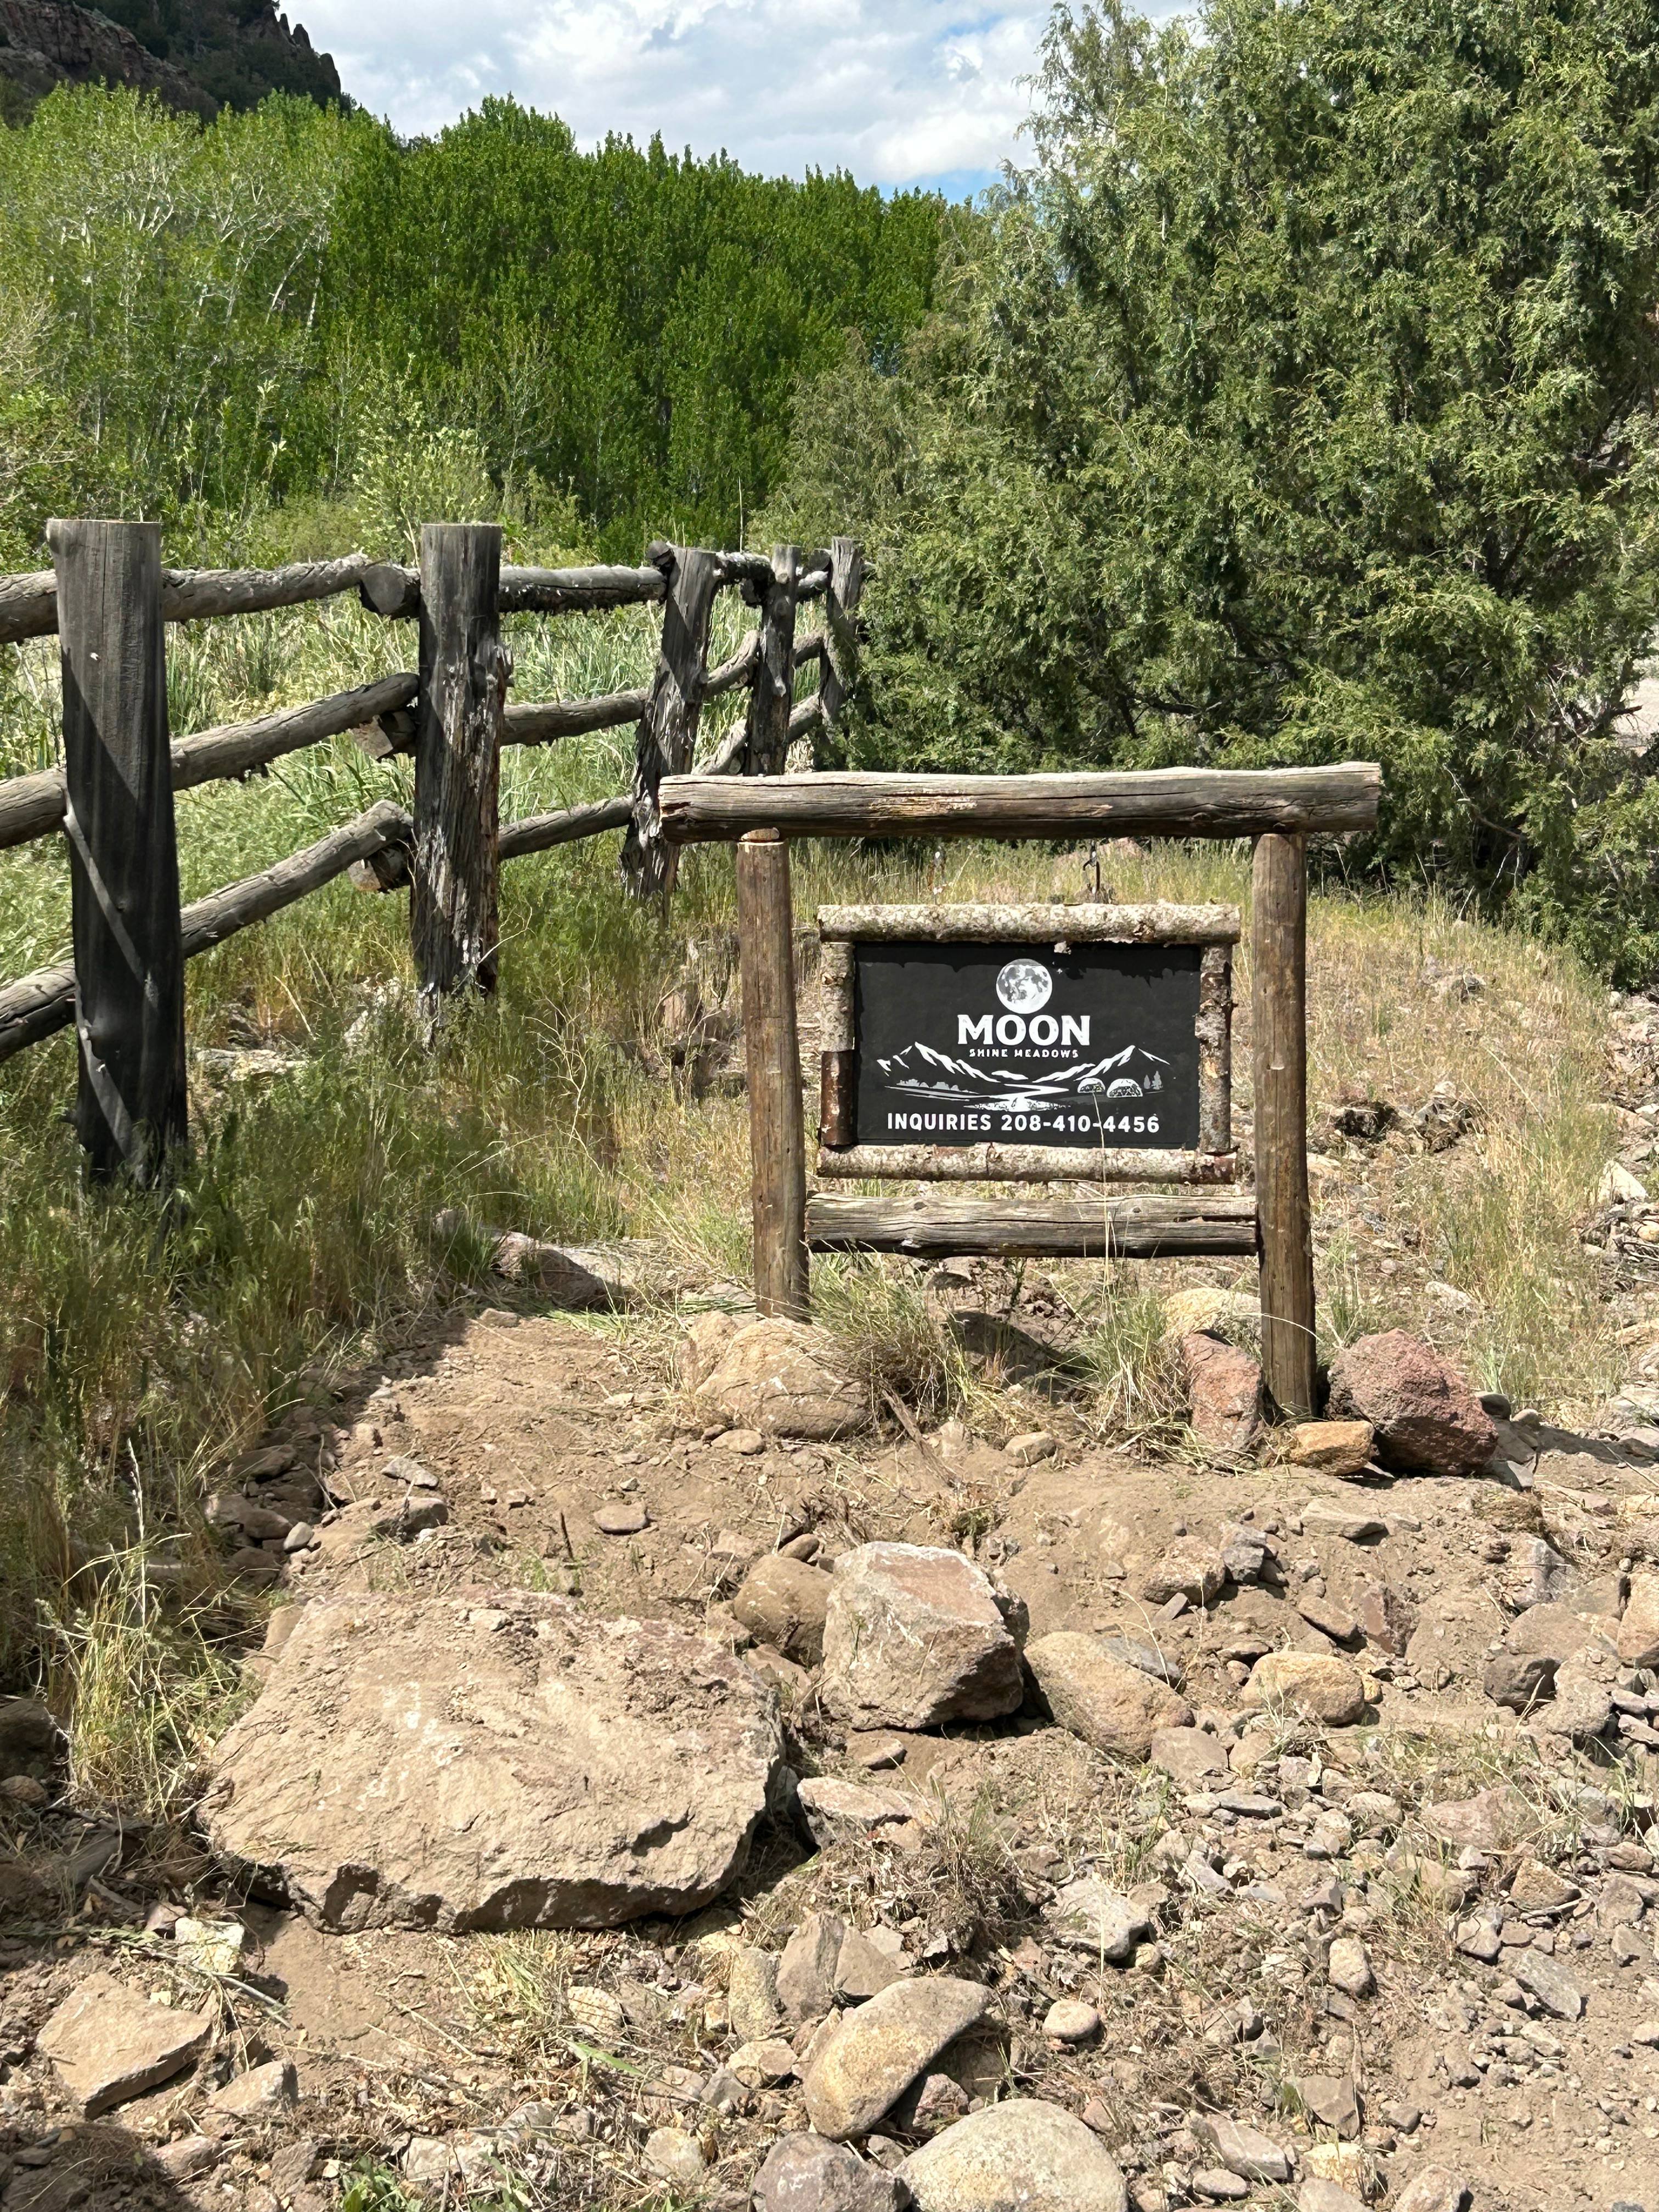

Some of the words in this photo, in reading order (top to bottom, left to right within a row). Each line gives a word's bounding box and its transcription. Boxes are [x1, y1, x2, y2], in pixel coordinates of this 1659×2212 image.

[957, 1014, 1090, 1046] MOON
[969, 1048, 1008, 1058] SHINE
[1014, 1048, 1079, 1059] MEADOWS
[887, 1113, 992, 1131] INQUIRIES
[1001, 1114, 1160, 1133] 208-410-4456
